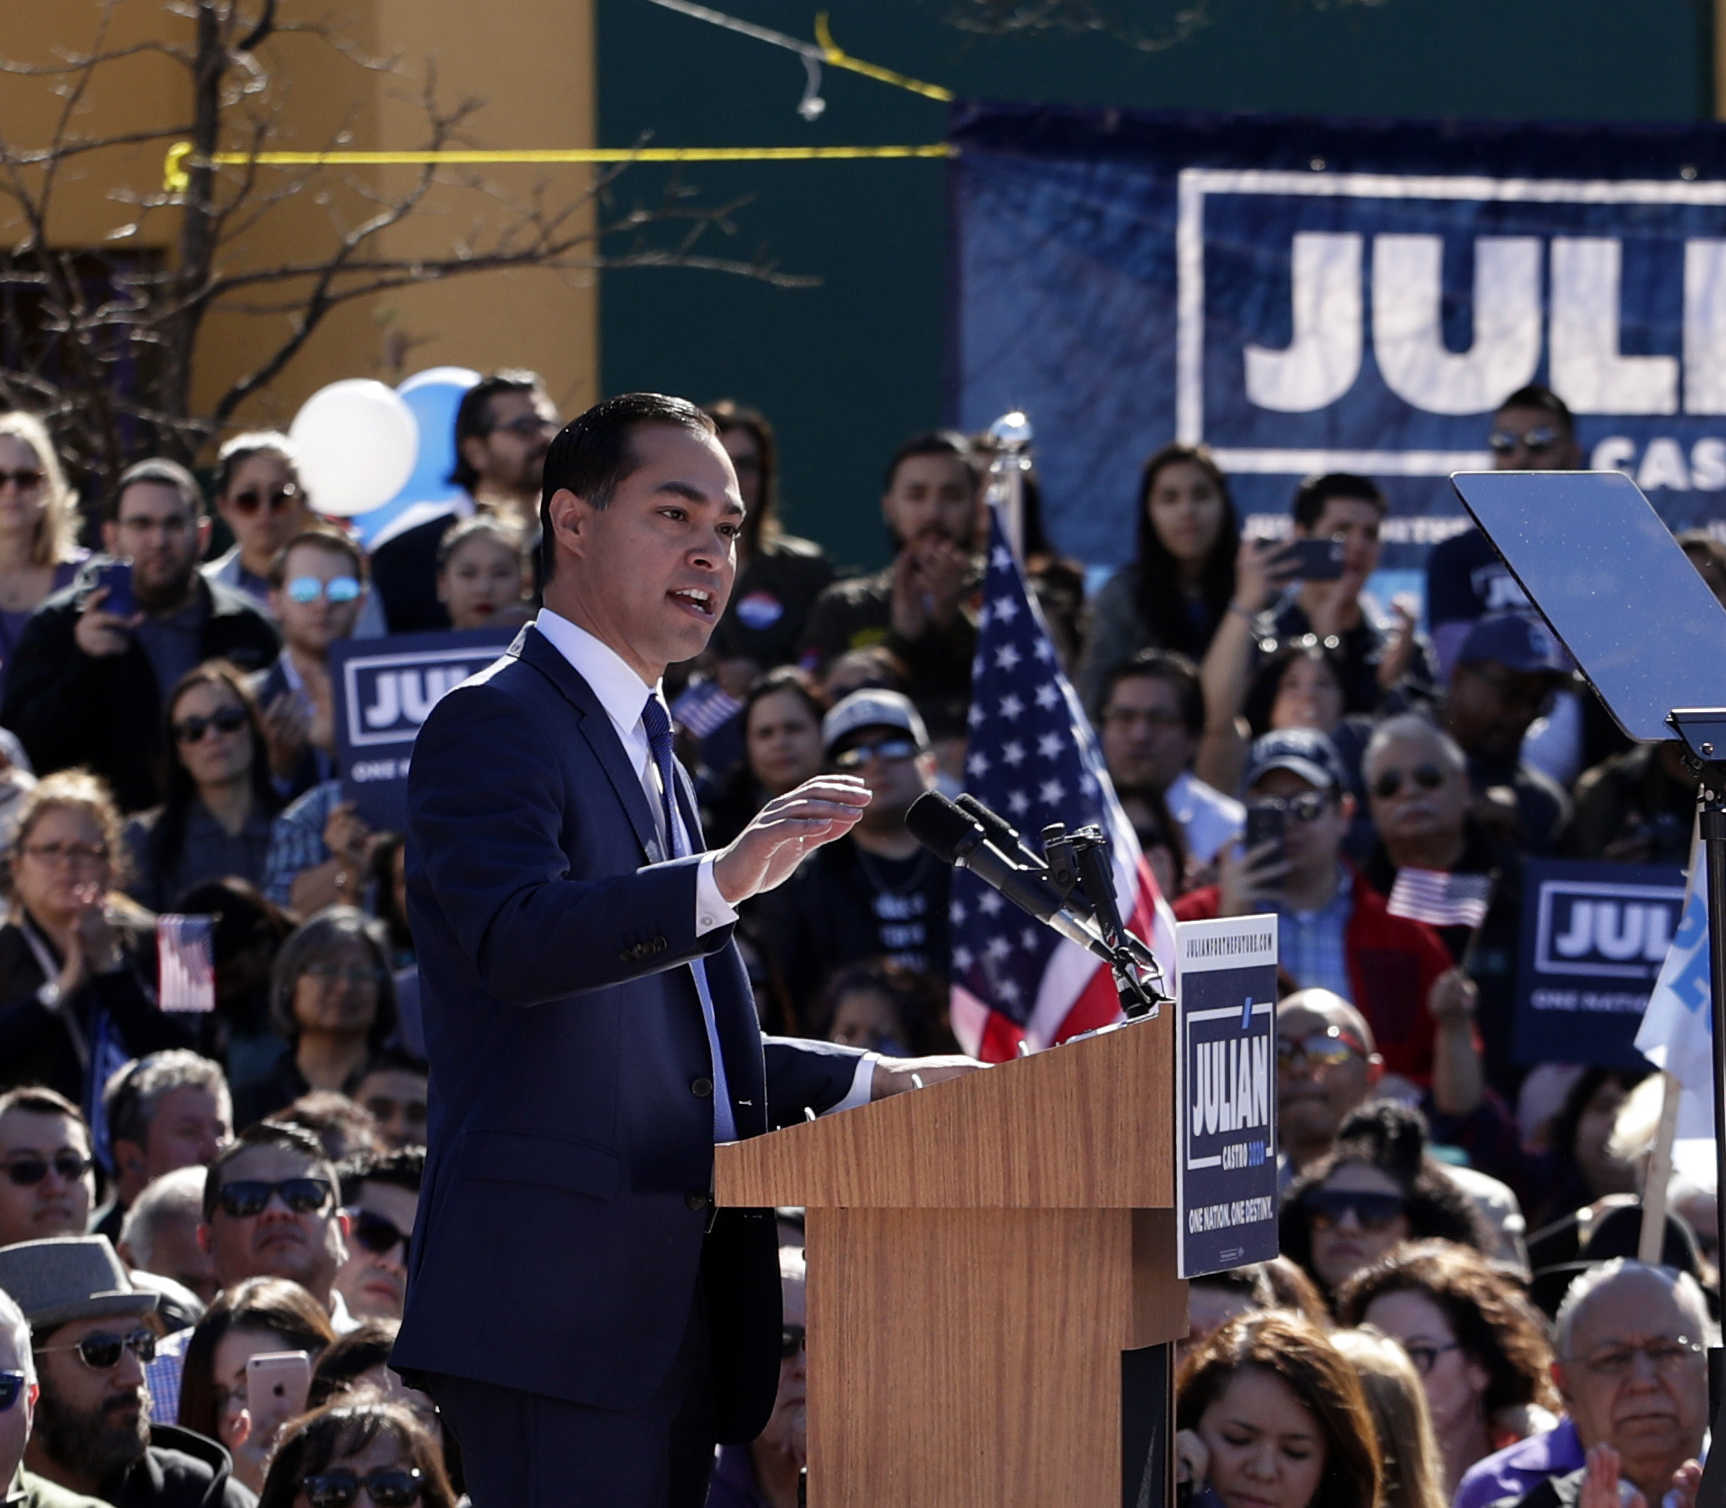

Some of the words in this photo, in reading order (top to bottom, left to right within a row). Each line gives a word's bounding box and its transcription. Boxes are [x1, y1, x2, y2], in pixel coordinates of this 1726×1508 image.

[1192, 997, 1268, 1137] JULIÁN
[1222, 1142, 1248, 1170] CASTRO
[1189, 1207, 1203, 1234] ONE
[1231, 1200, 1245, 1226] ONE
